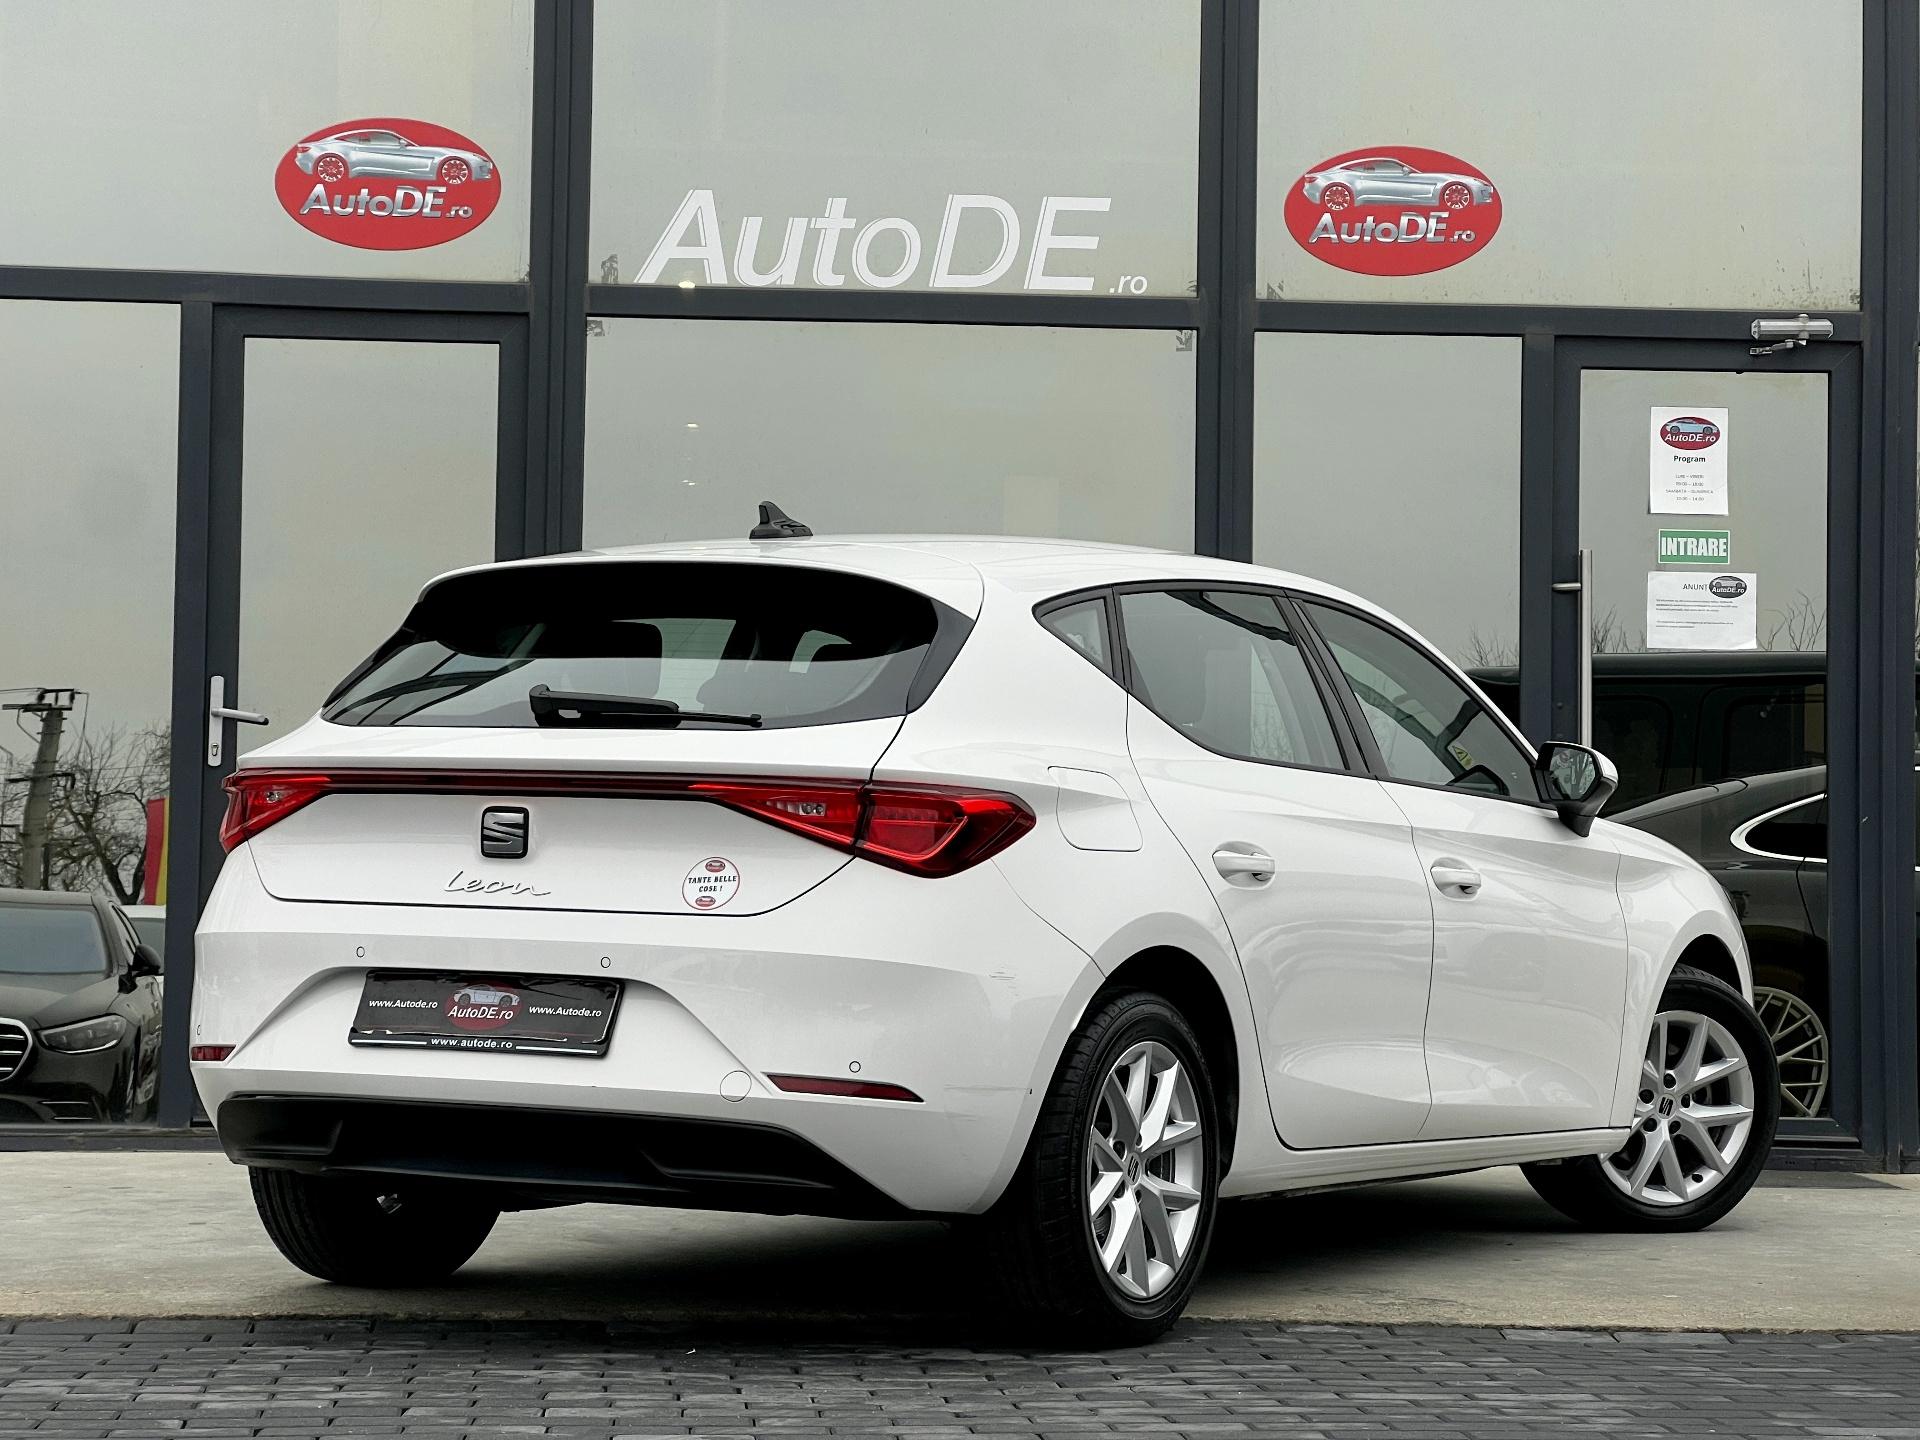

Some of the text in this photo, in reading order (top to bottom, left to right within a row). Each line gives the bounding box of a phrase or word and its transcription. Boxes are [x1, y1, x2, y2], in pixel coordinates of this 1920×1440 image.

[1664, 433, 1716, 442] AutoDE.ro
[1673, 455, 1706, 463] Program
[1661, 537, 1727, 556] INTRARE
[444, 870, 551, 896] Leon
[688, 875, 738, 884] TANTE BELLE
[368, 998, 438, 1009] www.Autode.ro
[447, 1005, 514, 1020] AutoDE.ro
[529, 1005, 602, 1017] www.Autode.ro
[430, 1036, 513, 1049] www.autode.ro
